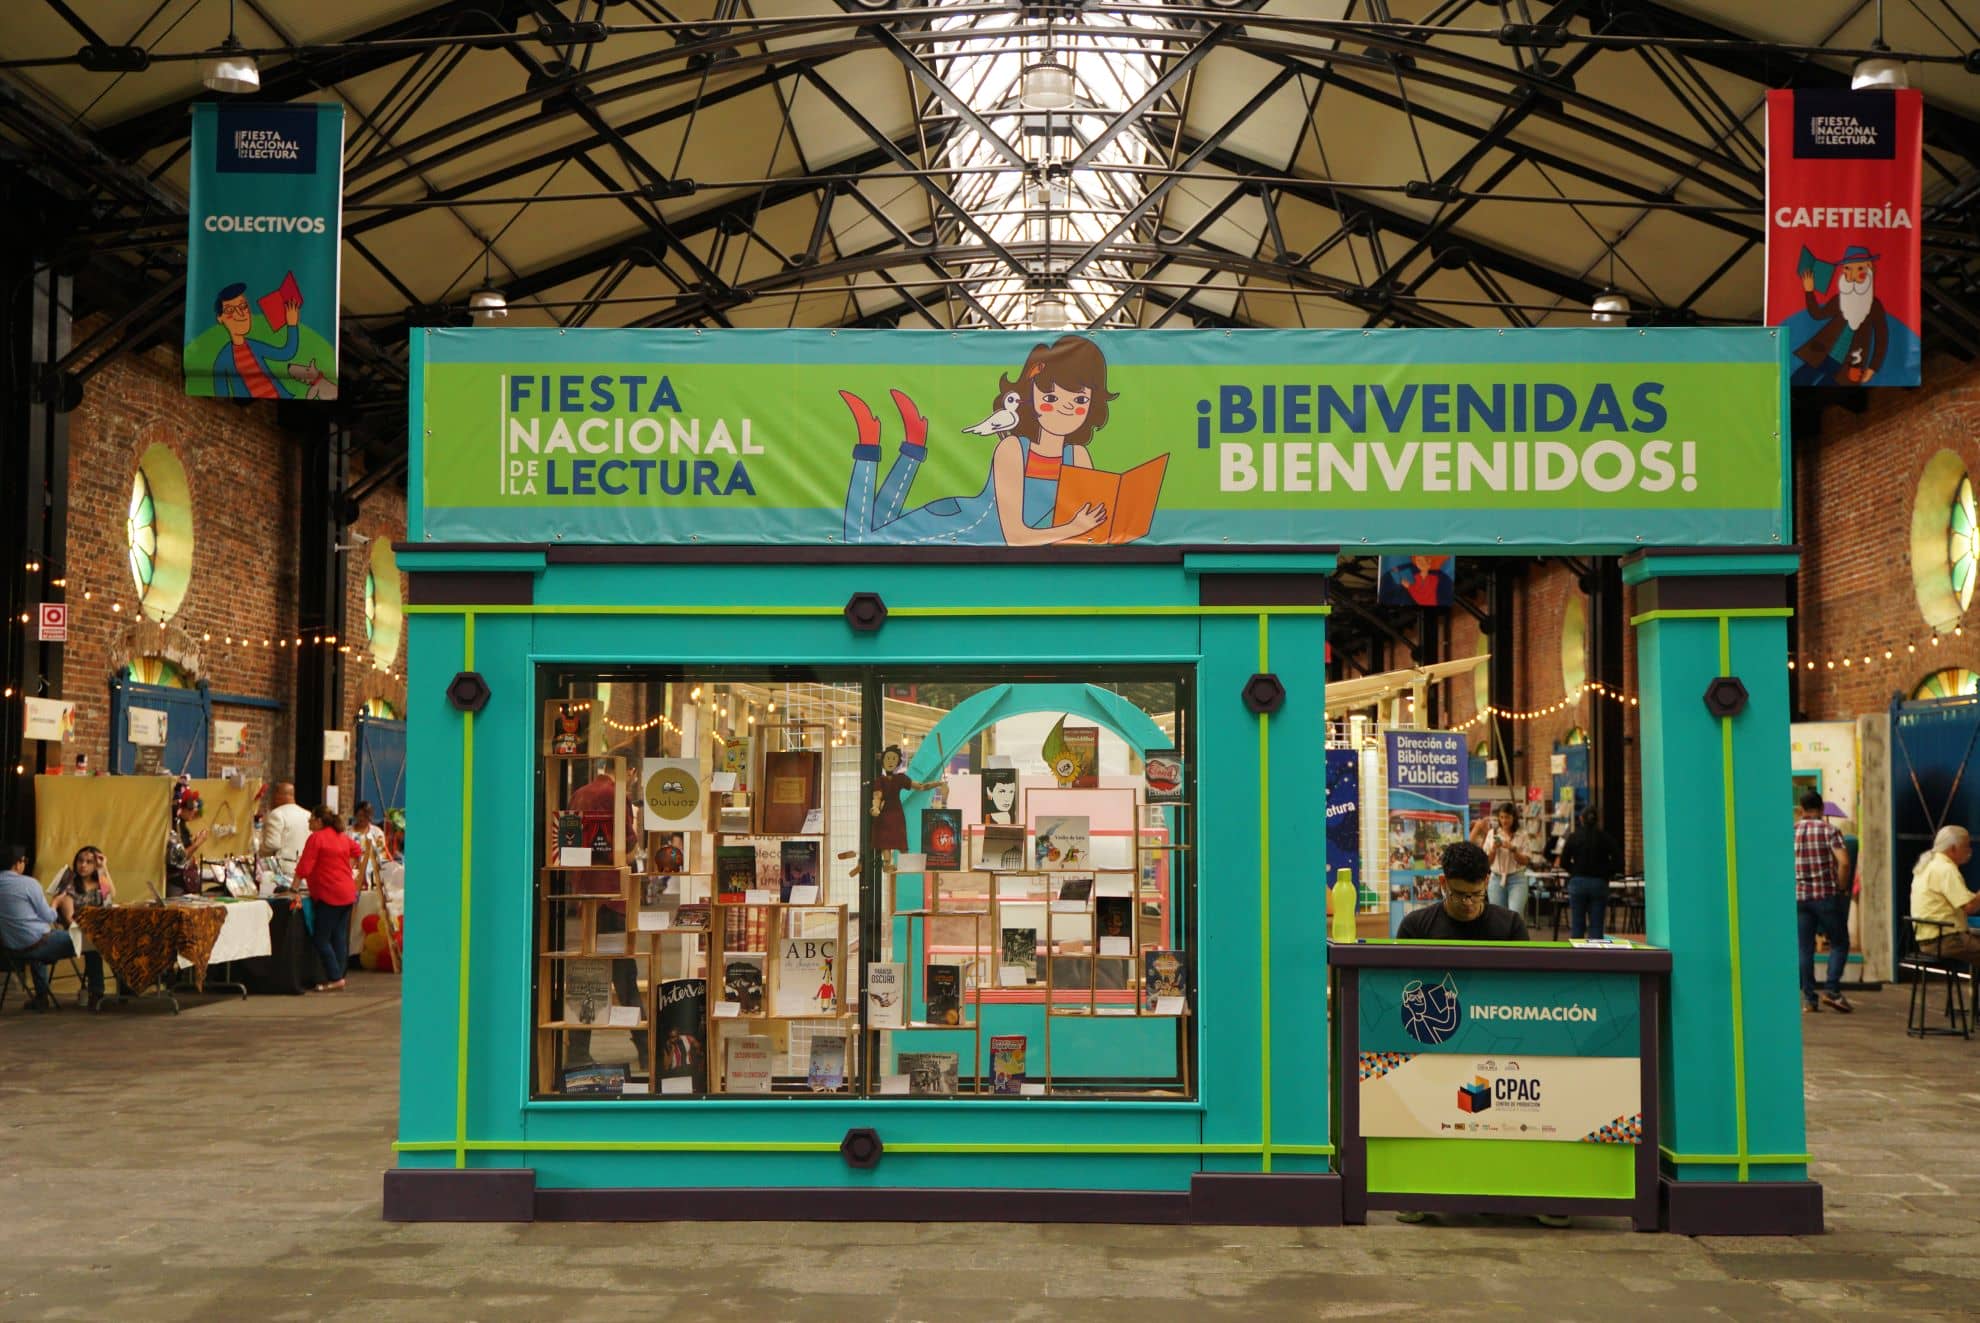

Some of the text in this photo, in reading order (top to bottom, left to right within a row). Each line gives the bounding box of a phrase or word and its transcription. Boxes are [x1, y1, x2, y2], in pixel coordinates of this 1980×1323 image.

[1817, 116, 1859, 126] FIESTA
[241, 130, 281, 140] FIESTA
[1817, 126, 1878, 136] NACIONAL
[241, 140, 300, 150] NACIONAL
[1826, 136, 1876, 145] LECTURA
[249, 150, 298, 159] LECTURA
[204, 215, 326, 234] COLECTIVOS
[1775, 202, 1913, 229] CAFETERÍA
[510, 375, 683, 413] FIESTA
[1196, 382, 1668, 449] ¡BIENVENIDAS
[510, 418, 765, 454] NACIONAL
[510, 460, 540, 477] DE
[1219, 439, 1698, 493] BIENVENIDOS!
[546, 459, 757, 496] LECTURA
[510, 479, 538, 496] LA
[1397, 736, 1458, 750] Dirección de
[1397, 750, 1457, 765] Bibliotecas
[1398, 765, 1460, 785] Públicas
[1470, 1003, 1597, 1022] INFORMACIÓN
[1495, 1078, 1541, 1101] CPAC
